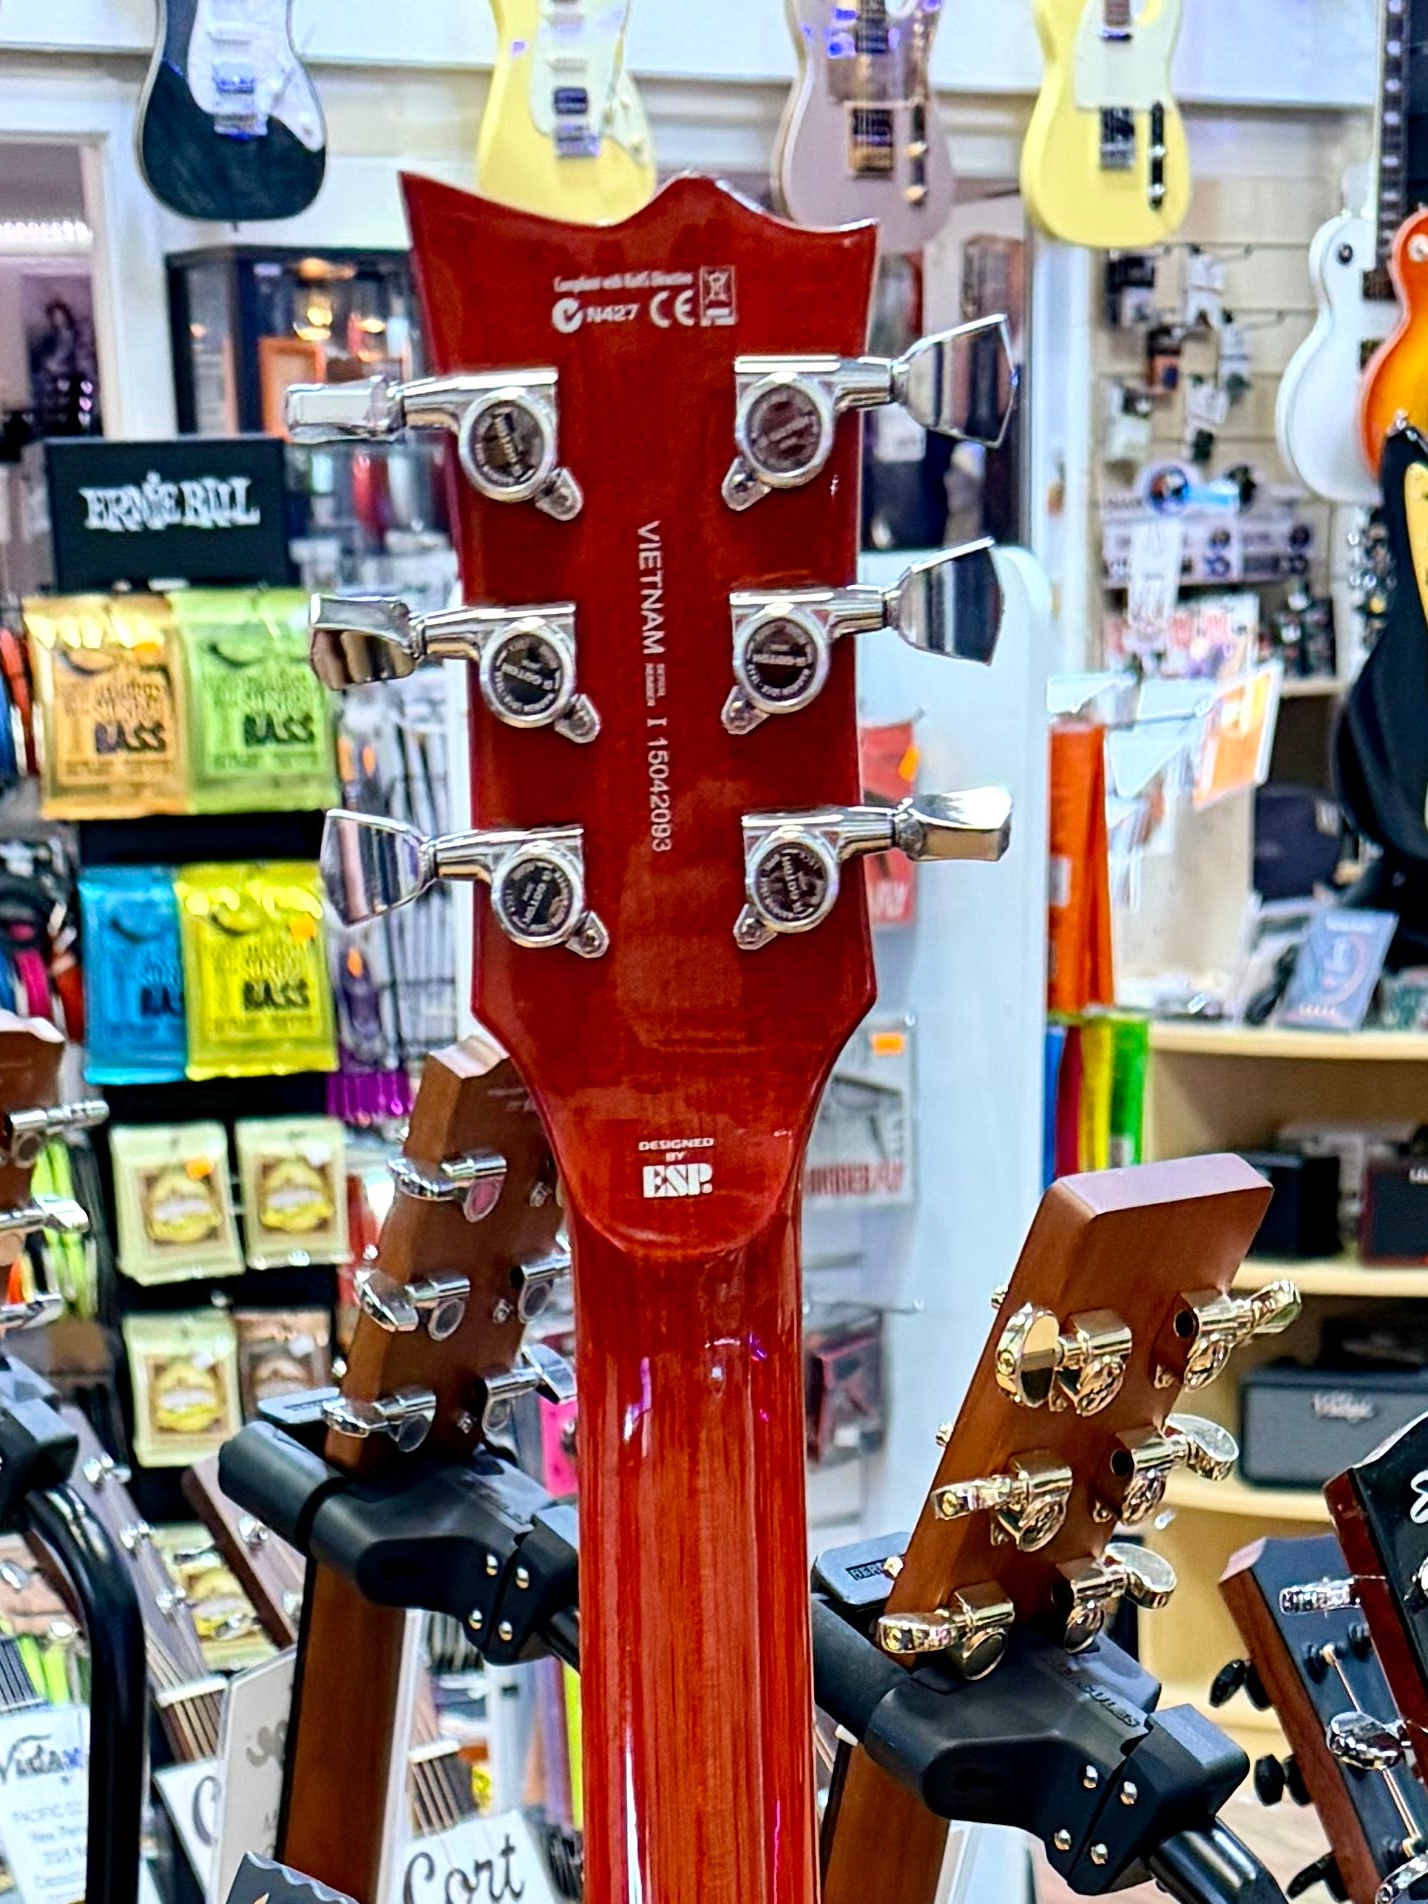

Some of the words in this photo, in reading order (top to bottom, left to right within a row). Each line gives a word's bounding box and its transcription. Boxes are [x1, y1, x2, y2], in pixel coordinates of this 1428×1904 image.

[586, 303, 641, 324] N427
[79, 470, 183, 533] ERNIE
[637, 520, 666, 655] VIETNAM
[647, 736, 673, 853] 15042093
[638, 1137, 715, 1153] DESIGNED
[665, 1150, 687, 1163] BY
